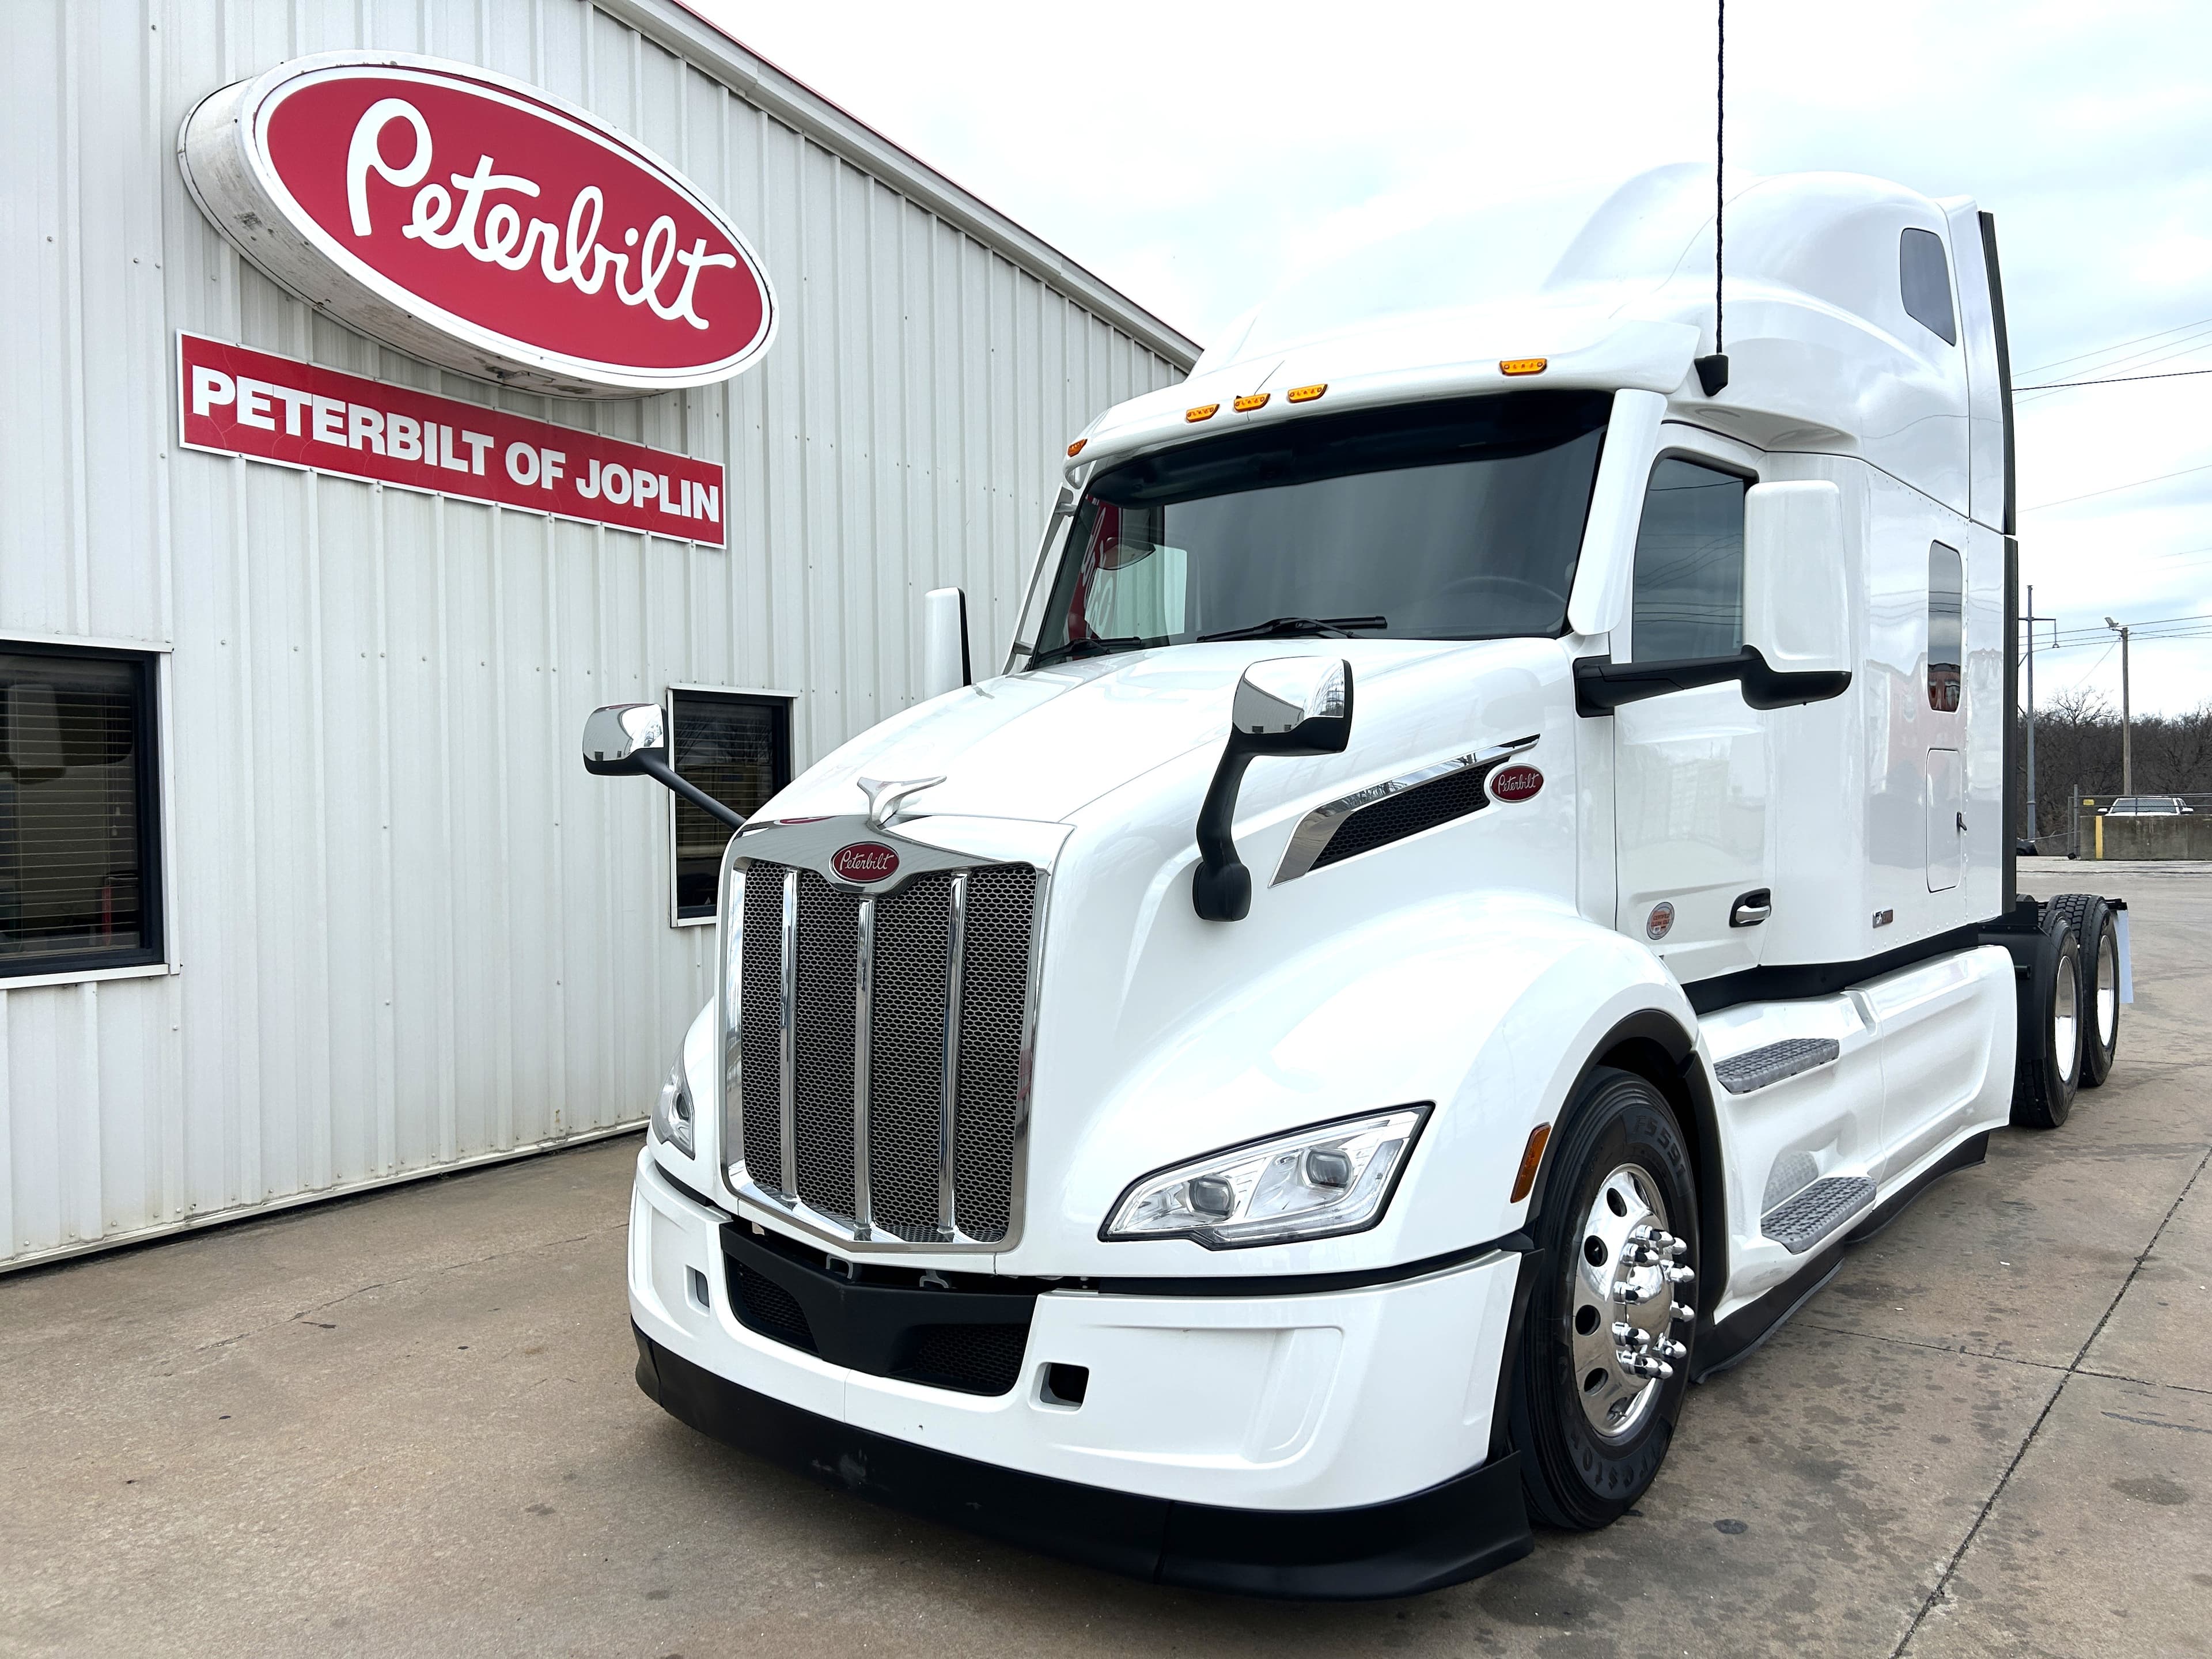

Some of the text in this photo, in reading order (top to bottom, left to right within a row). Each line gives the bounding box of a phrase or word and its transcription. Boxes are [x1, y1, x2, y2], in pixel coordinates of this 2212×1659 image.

[346, 98, 737, 330] Peterbilt
[192, 365, 719, 523] PETERBILT OF JOPLIN
[1498, 773, 1539, 794] Peterbilt
[839, 850, 895, 872] Peterbilt
[1633, 1115, 1685, 1179] FS591
